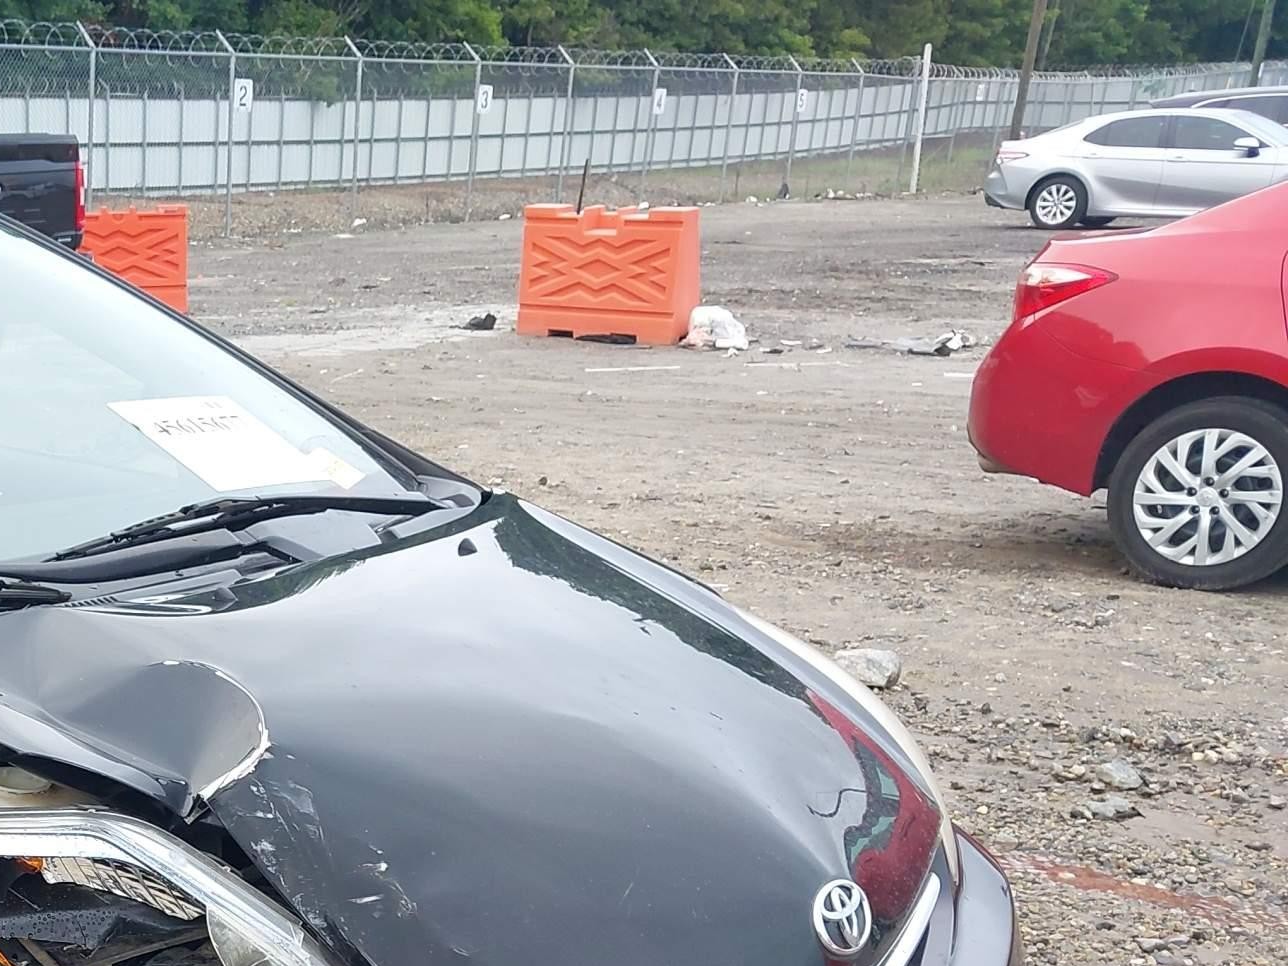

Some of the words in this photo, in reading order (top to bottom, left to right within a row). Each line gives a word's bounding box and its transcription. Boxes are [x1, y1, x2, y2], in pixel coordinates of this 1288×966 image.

[239, 85, 248, 107] 2
[481, 90, 489, 109] 3
[656, 94, 663, 110] 4
